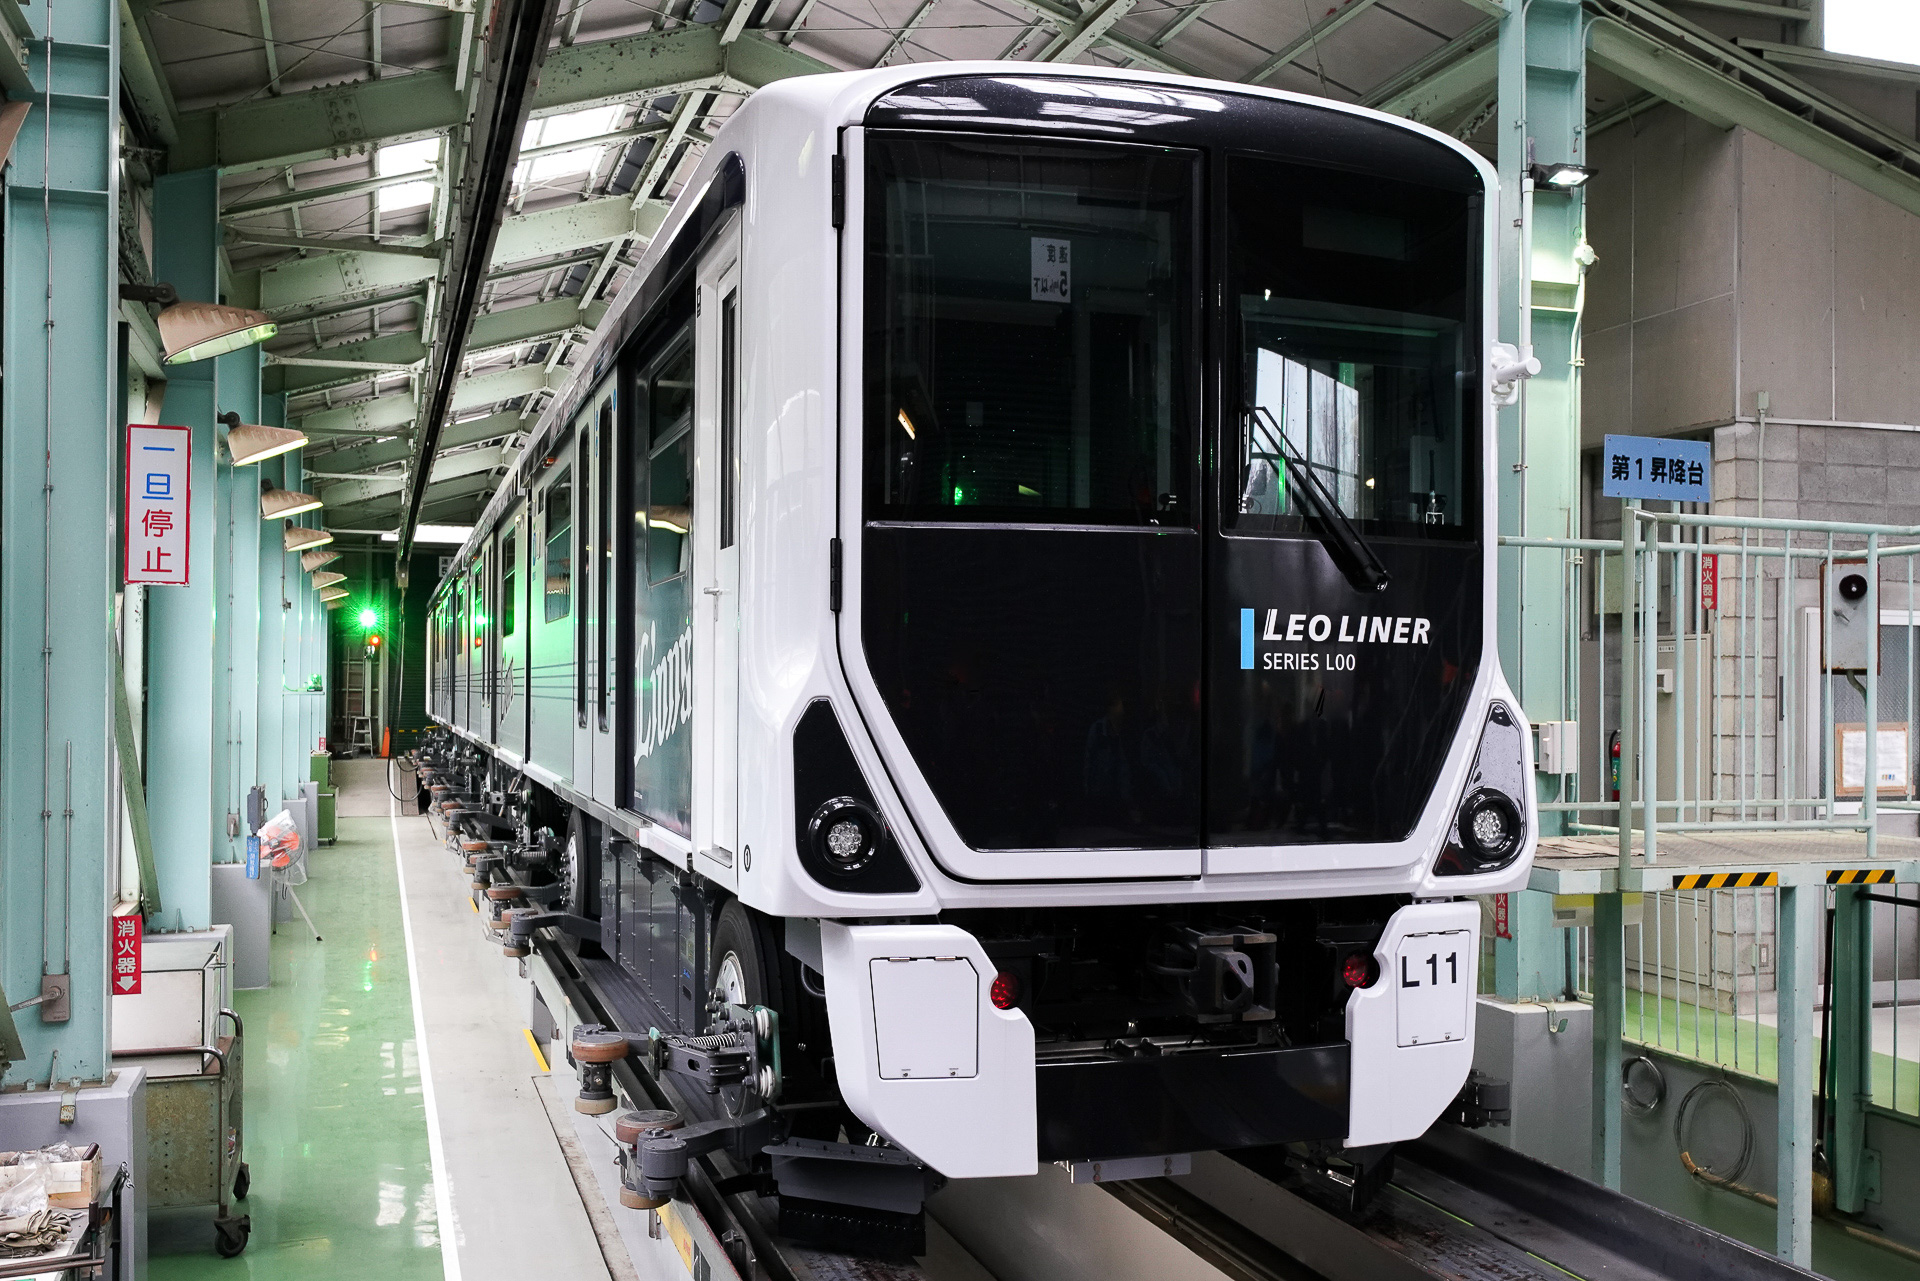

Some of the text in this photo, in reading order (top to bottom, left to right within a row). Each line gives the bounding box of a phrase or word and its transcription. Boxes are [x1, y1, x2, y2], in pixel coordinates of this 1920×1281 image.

[1611, 454, 1704, 486] 第1昇降台
[141, 446, 175, 573] 一旦停止
[1702, 556, 1713, 596] 消火器
[1263, 608, 1431, 645] LEO LINER
[1263, 653, 1320, 670] SERIES
[1497, 893, 1506, 921] 火器
[117, 920, 136, 974] 消火器
[1401, 951, 1457, 988] L11
